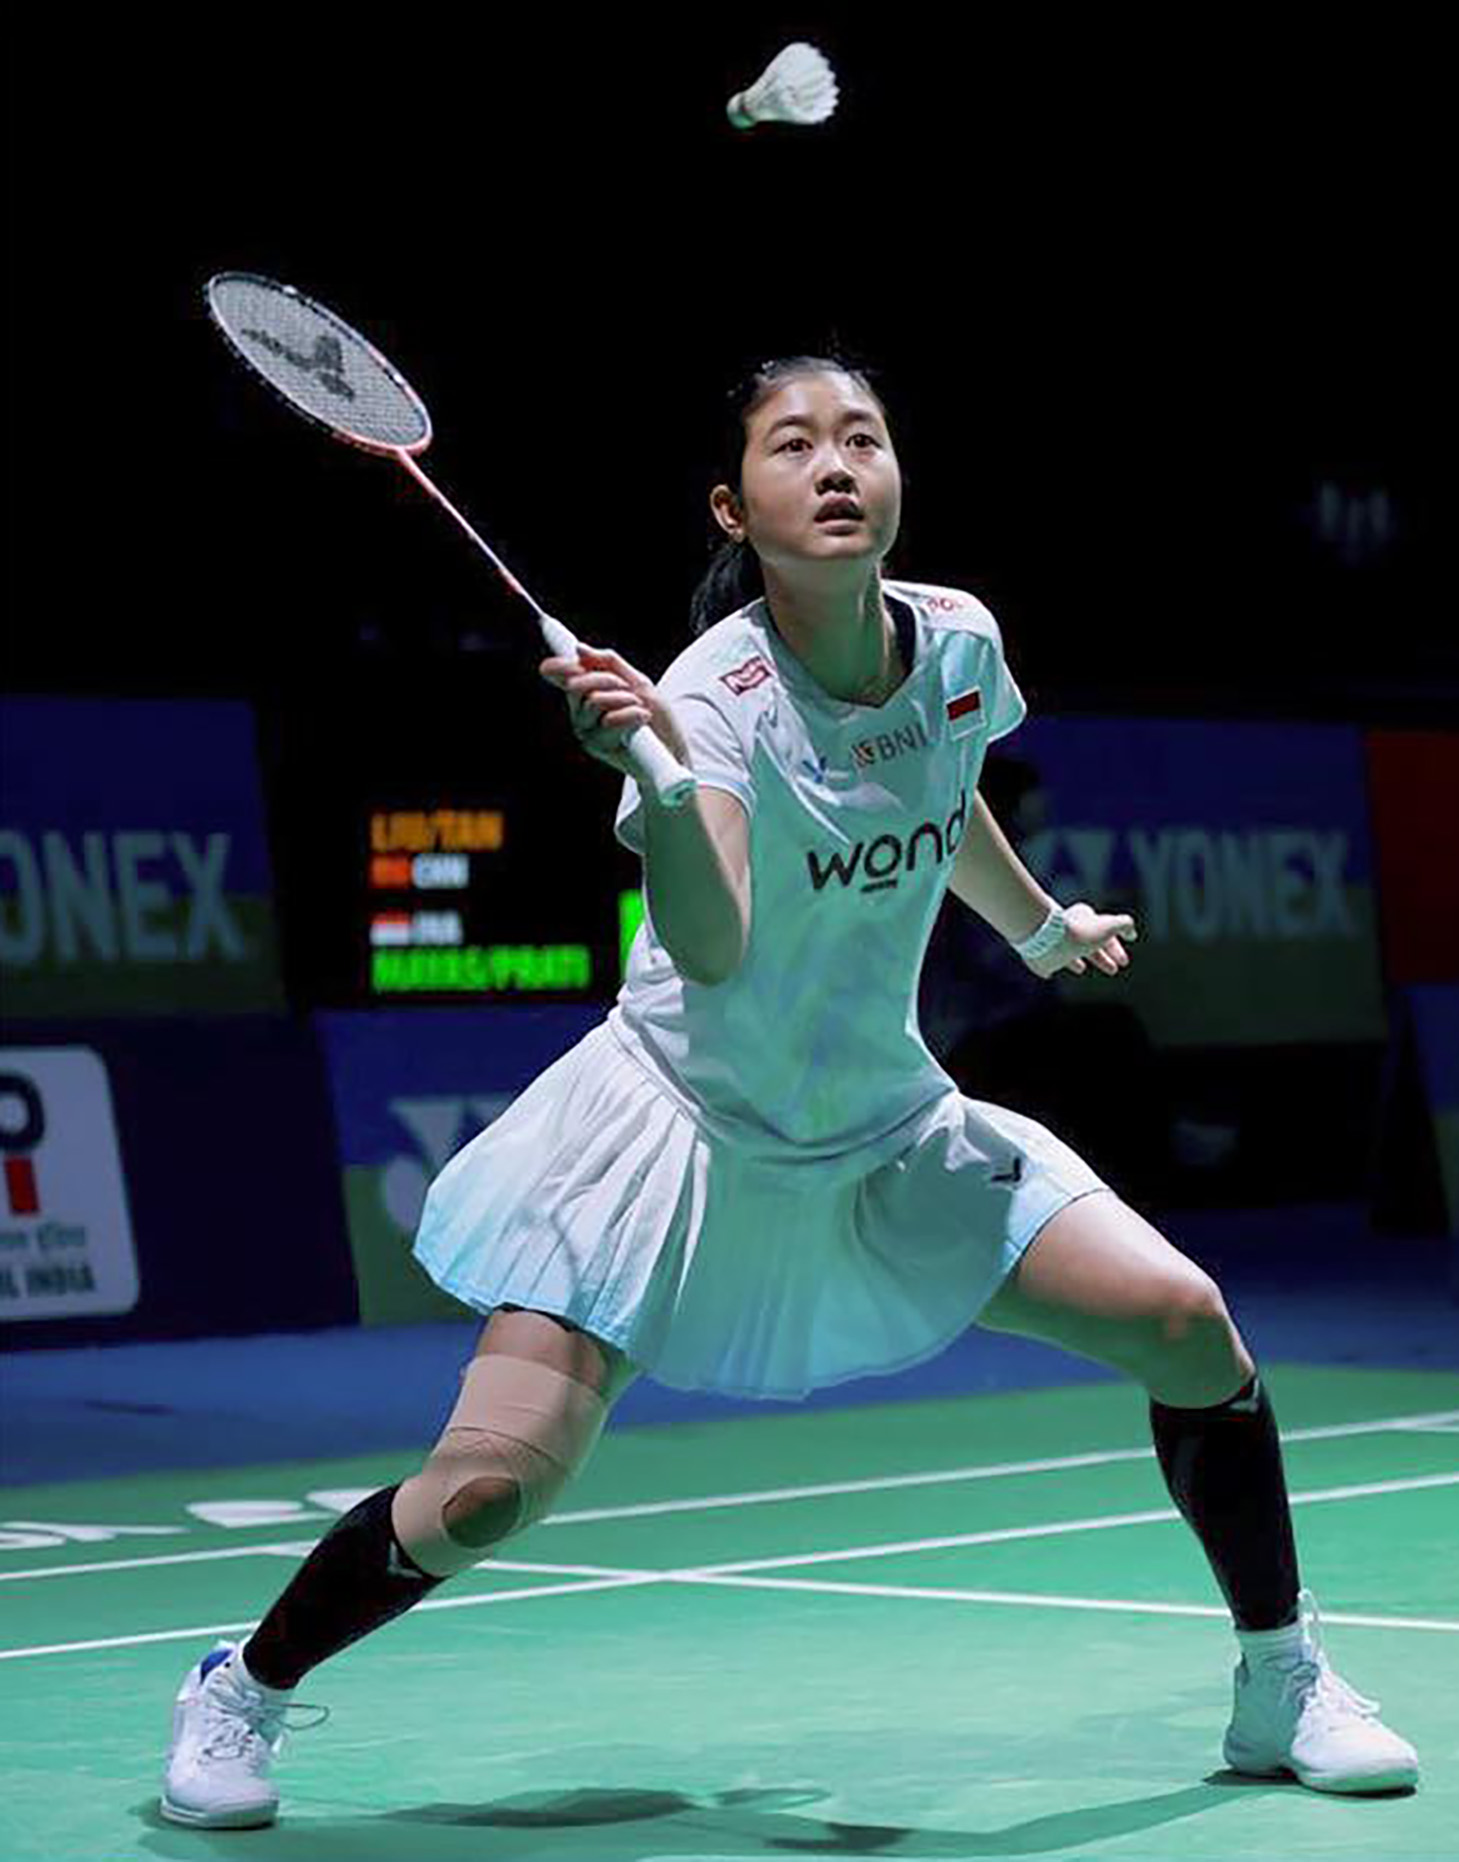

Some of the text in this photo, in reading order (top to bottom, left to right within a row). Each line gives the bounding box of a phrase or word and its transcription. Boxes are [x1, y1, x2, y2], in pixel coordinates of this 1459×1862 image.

[872, 720, 929, 761] BNI
[806, 788, 967, 892] wond
[1130, 827, 1362, 942] YONEX
[0, 830, 245, 963] ONEX
